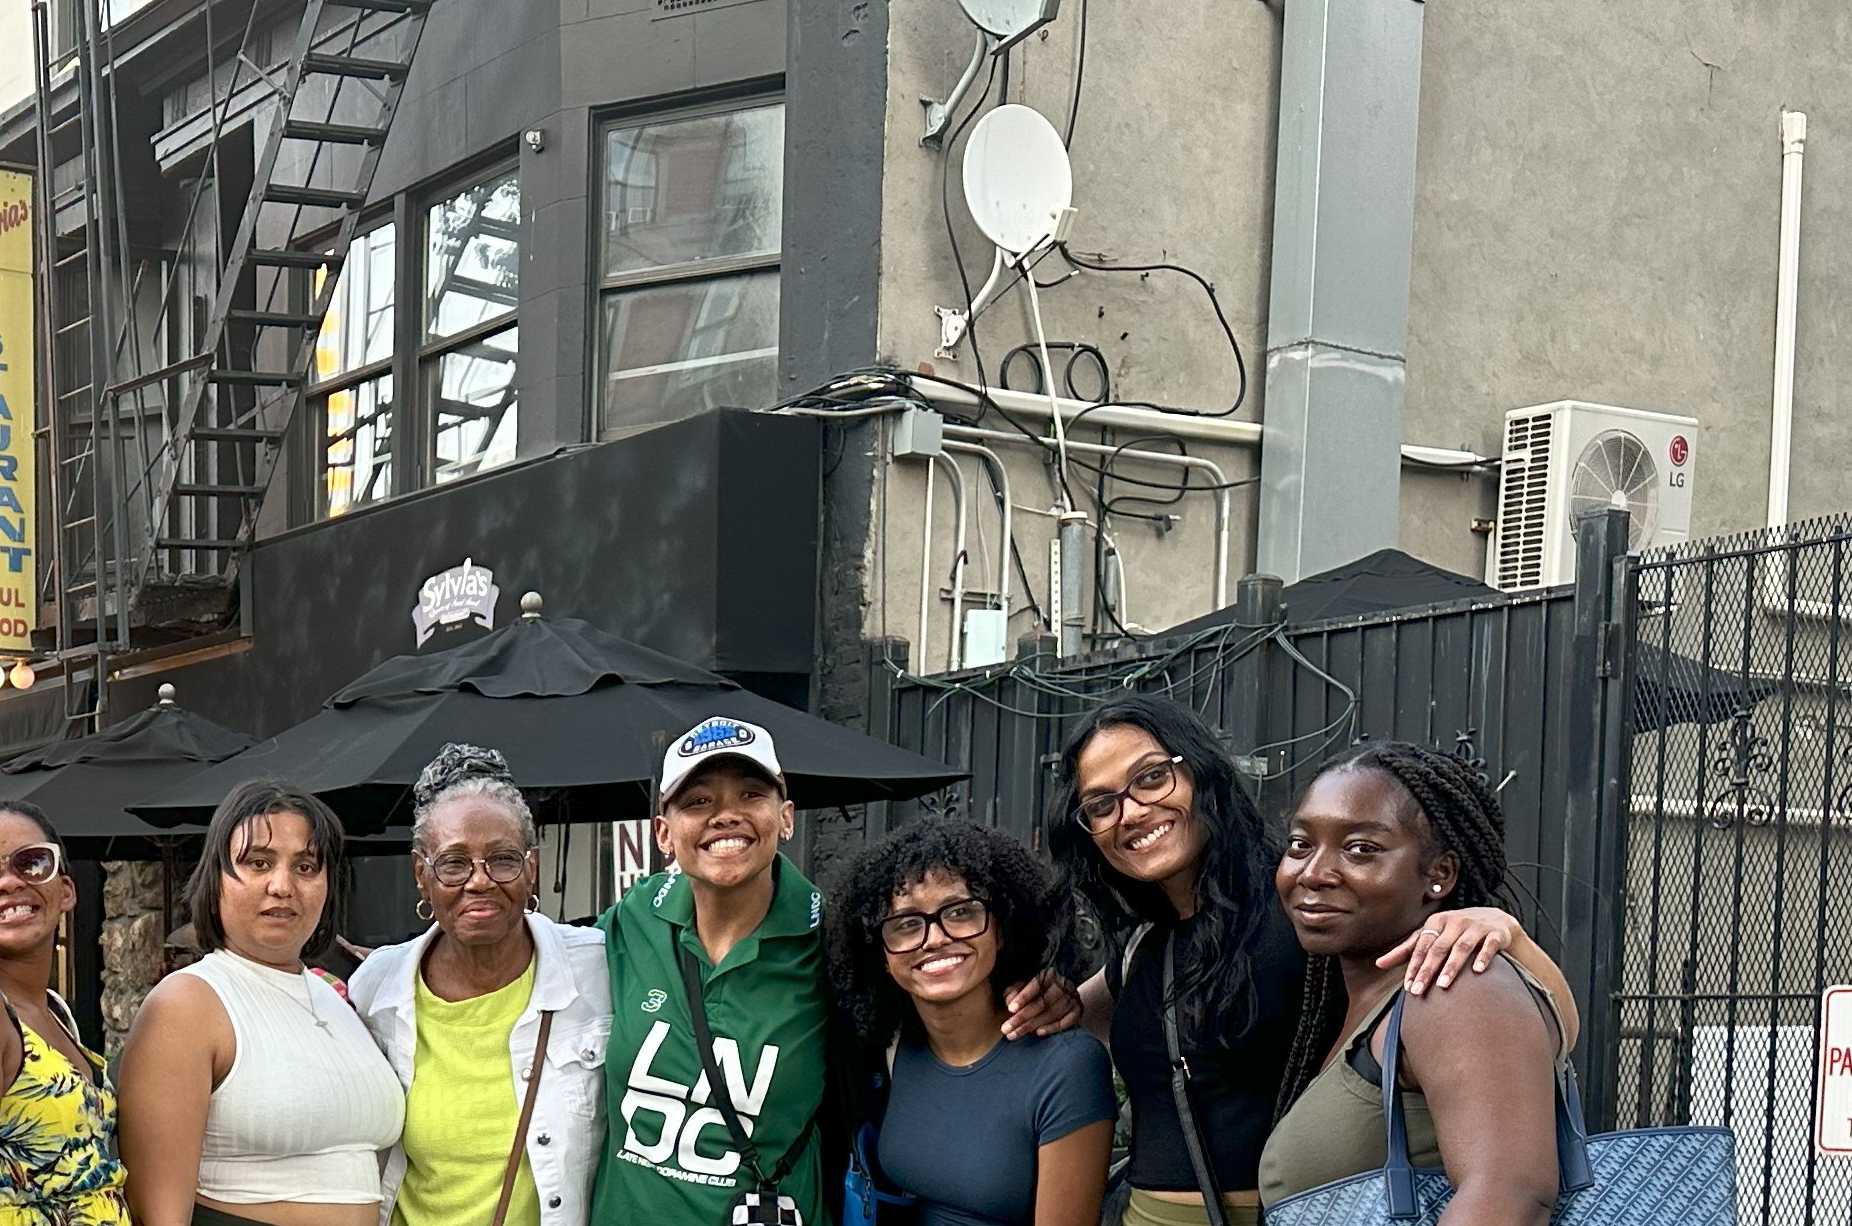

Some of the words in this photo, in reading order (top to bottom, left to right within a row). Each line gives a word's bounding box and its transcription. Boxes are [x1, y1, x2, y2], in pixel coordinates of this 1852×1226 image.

[1669, 471, 1685, 488] LG
[422, 557, 488, 613] Sylvia's
[693, 736, 741, 753] GARAGE
[707, 1175, 737, 1188] CLUB
